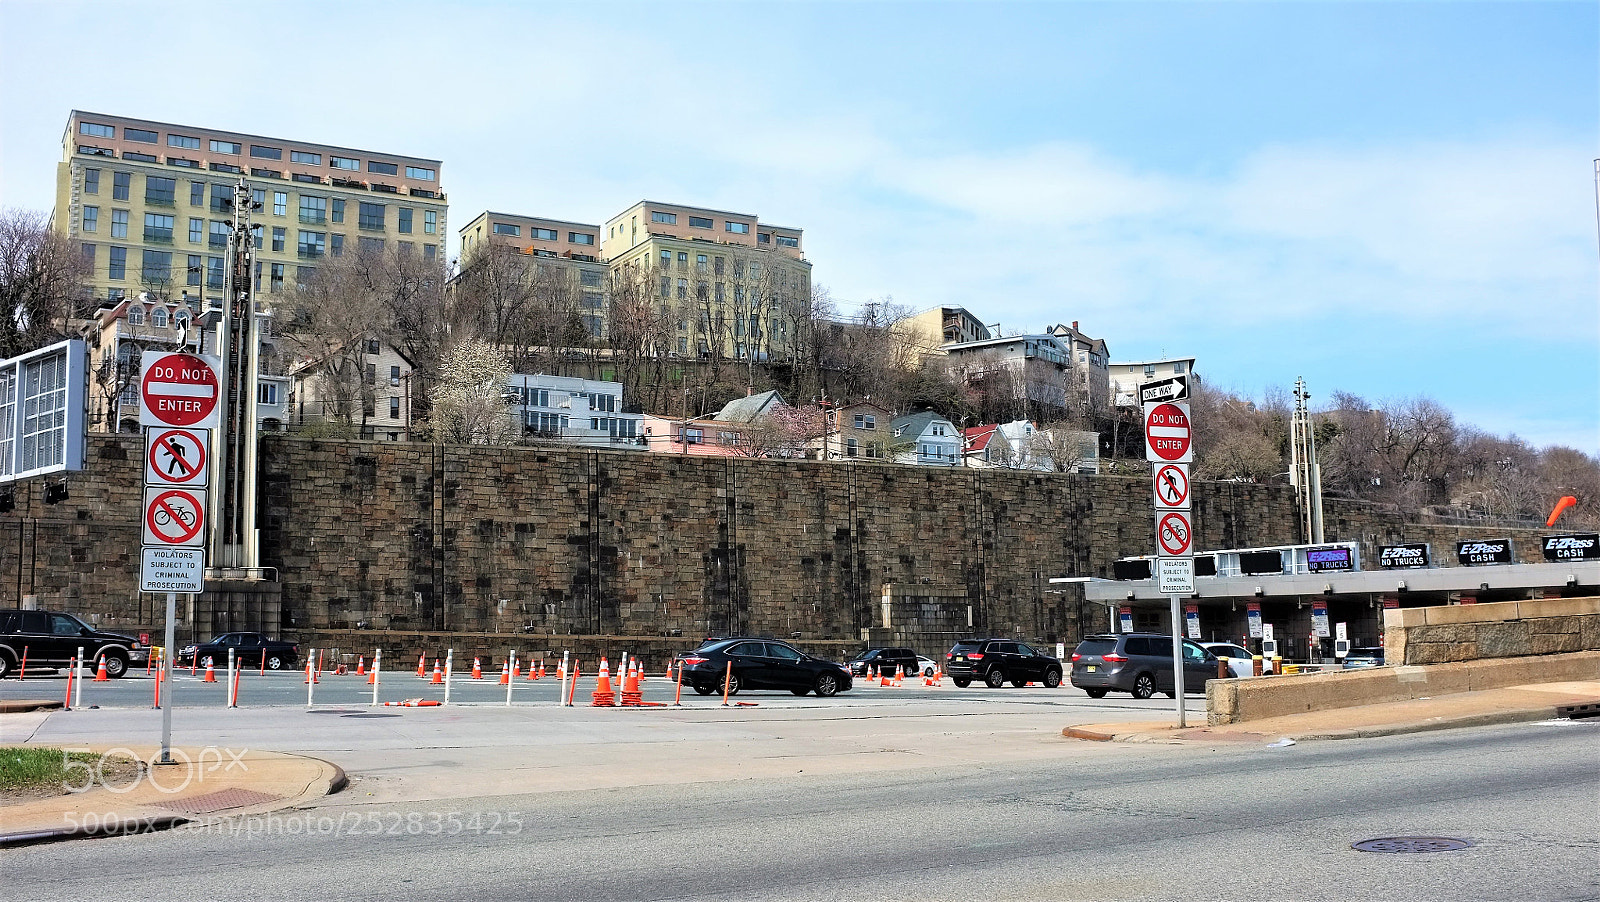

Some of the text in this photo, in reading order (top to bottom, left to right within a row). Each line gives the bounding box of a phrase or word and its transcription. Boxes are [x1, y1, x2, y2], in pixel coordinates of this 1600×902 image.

[155, 366, 209, 381] DO NOT
[1144, 385, 1172, 399] ONE WAY
[158, 399, 202, 412] ENTER
[1153, 414, 1184, 425] DO NOT
[1157, 440, 1182, 450] ENTER
[153, 551, 193, 559] VIOLATORS
[1470, 553, 1495, 562] CASH
[1556, 549, 1584, 558] CASH
[150, 561, 182, 569] SUBJECT
[1309, 560, 1349, 570] NO TRUCKS
[1381, 556, 1424, 567] NO TRUCKS
[154, 571, 189, 579] CRIMINAL
[147, 581, 197, 589] PROSECUTION
